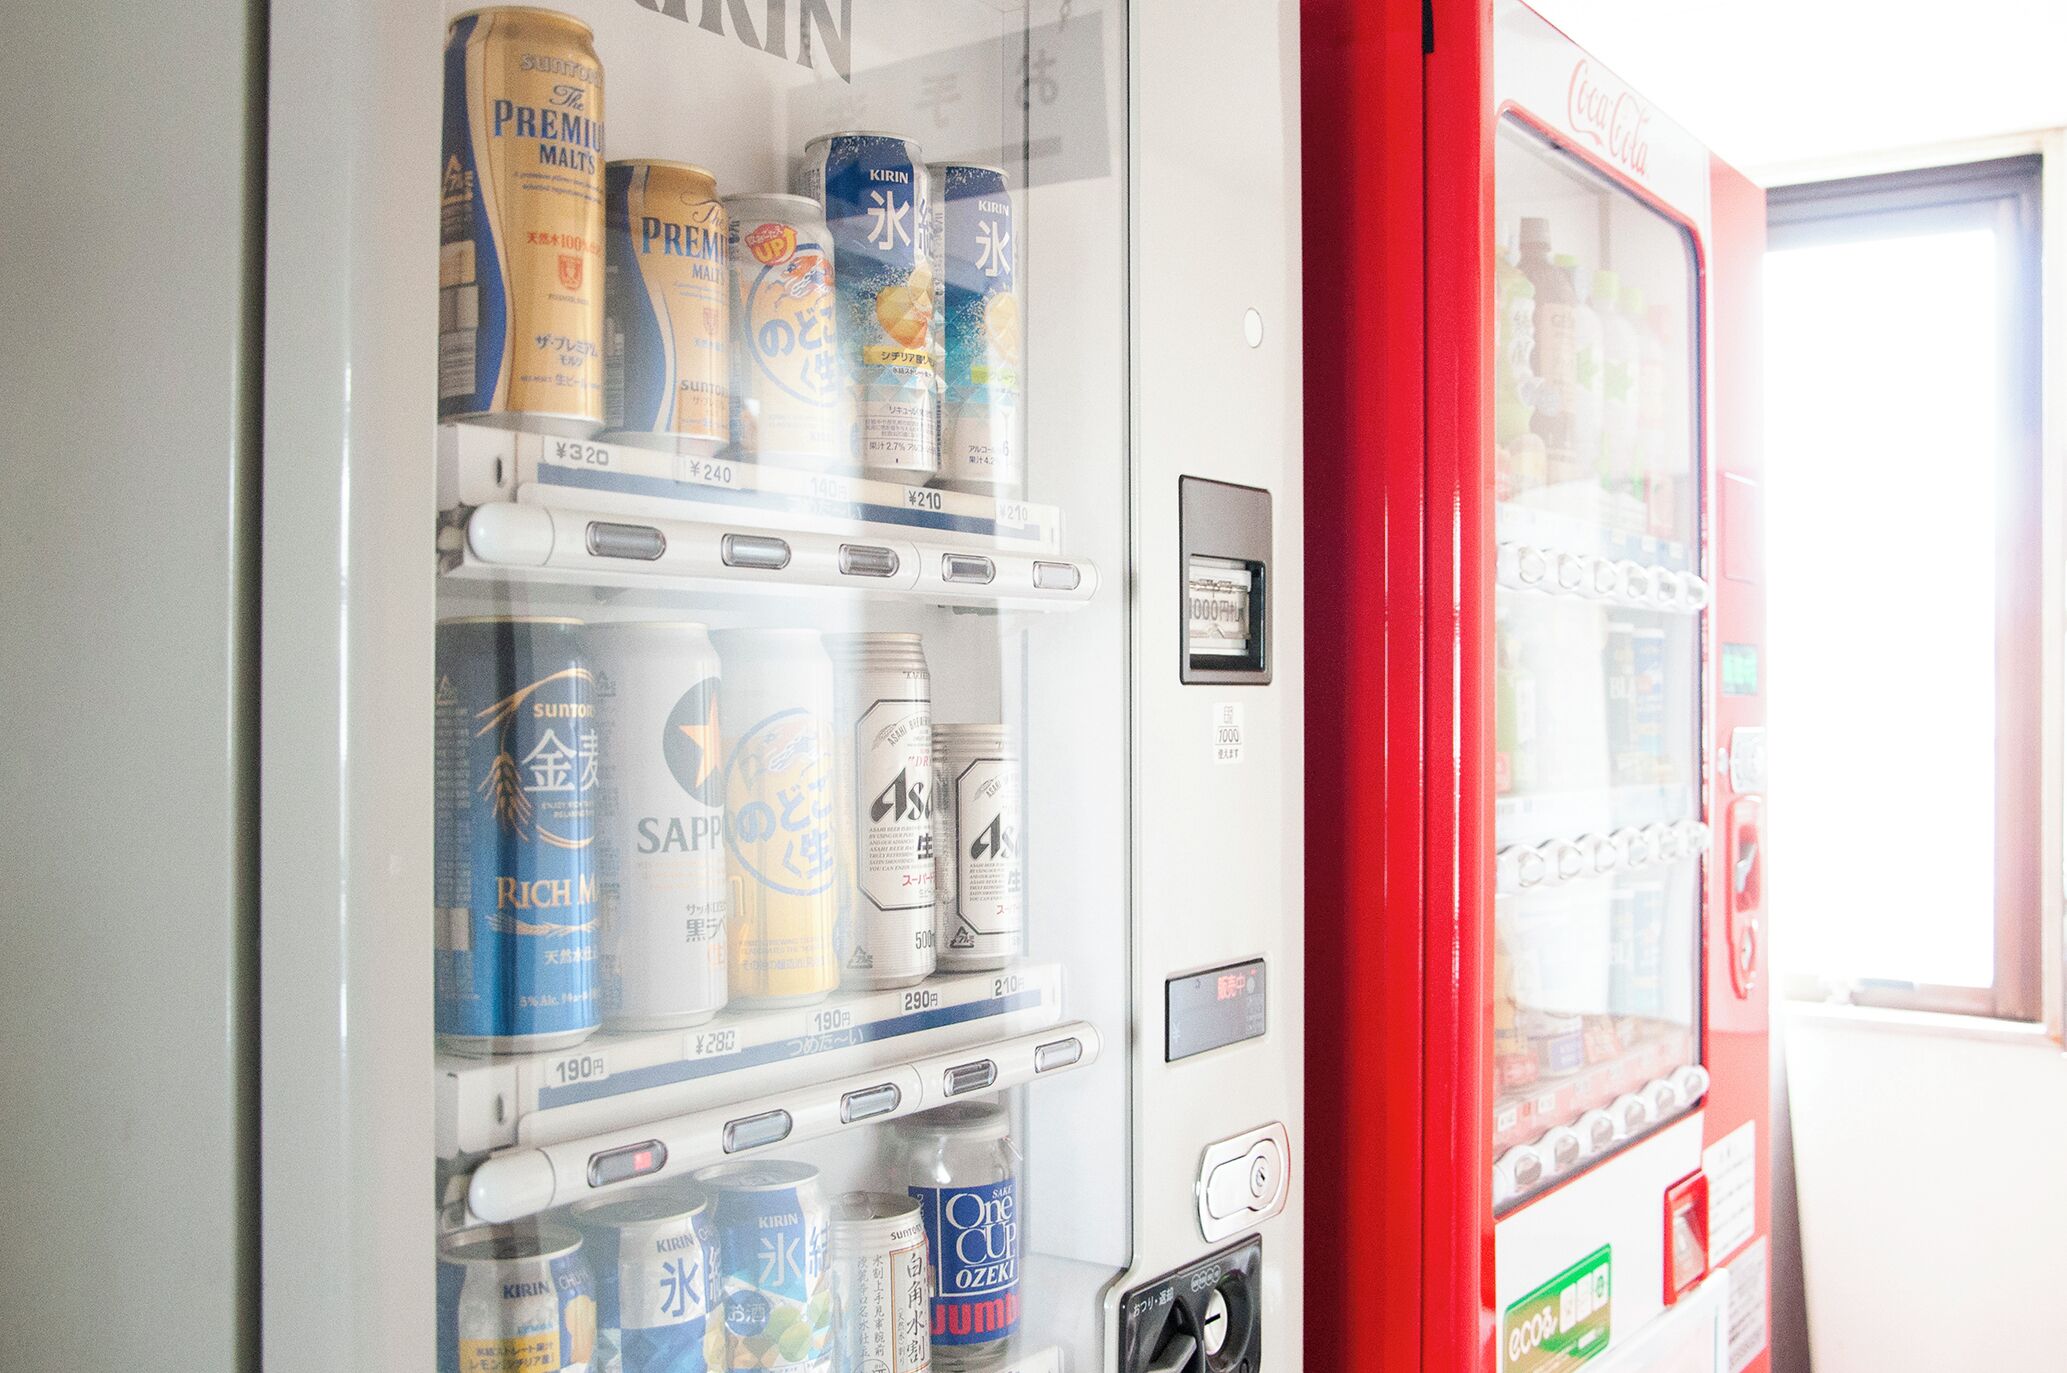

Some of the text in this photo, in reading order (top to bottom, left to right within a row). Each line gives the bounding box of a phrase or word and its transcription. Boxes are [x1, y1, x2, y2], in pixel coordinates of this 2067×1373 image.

[548, 84, 585, 111] The
[1568, 58, 1648, 176] Coca-Cola
[540, 144, 595, 176] MALT'S
[870, 169, 909, 184] KIRIN
[978, 200, 1010, 216] KIRIN
[756, 237, 785, 263] UP
[975, 220, 1012, 277] 氷
[555, 441, 609, 466] ¥320
[690, 459, 732, 483] ¥240
[908, 491, 942, 510] ¥210
[1218, 728, 1239, 743] 1000
[496, 876, 571, 909] RICH
[904, 990, 938, 1011] 290円
[814, 1008, 851, 1032] 190円
[696, 1030, 735, 1055] ¥280
[556, 1055, 604, 1083] 190円
[992, 1187, 1012, 1199] SAKE
[758, 1213, 798, 1228] KIRIN
[946, 1192, 1013, 1231] One
[656, 1233, 695, 1253] KIRIN
[957, 1221, 1017, 1266] CUP
[955, 1264, 1015, 1289] OZEKI
[503, 1281, 550, 1299] KIRIN
[906, 1252, 925, 1363] 白角水割
